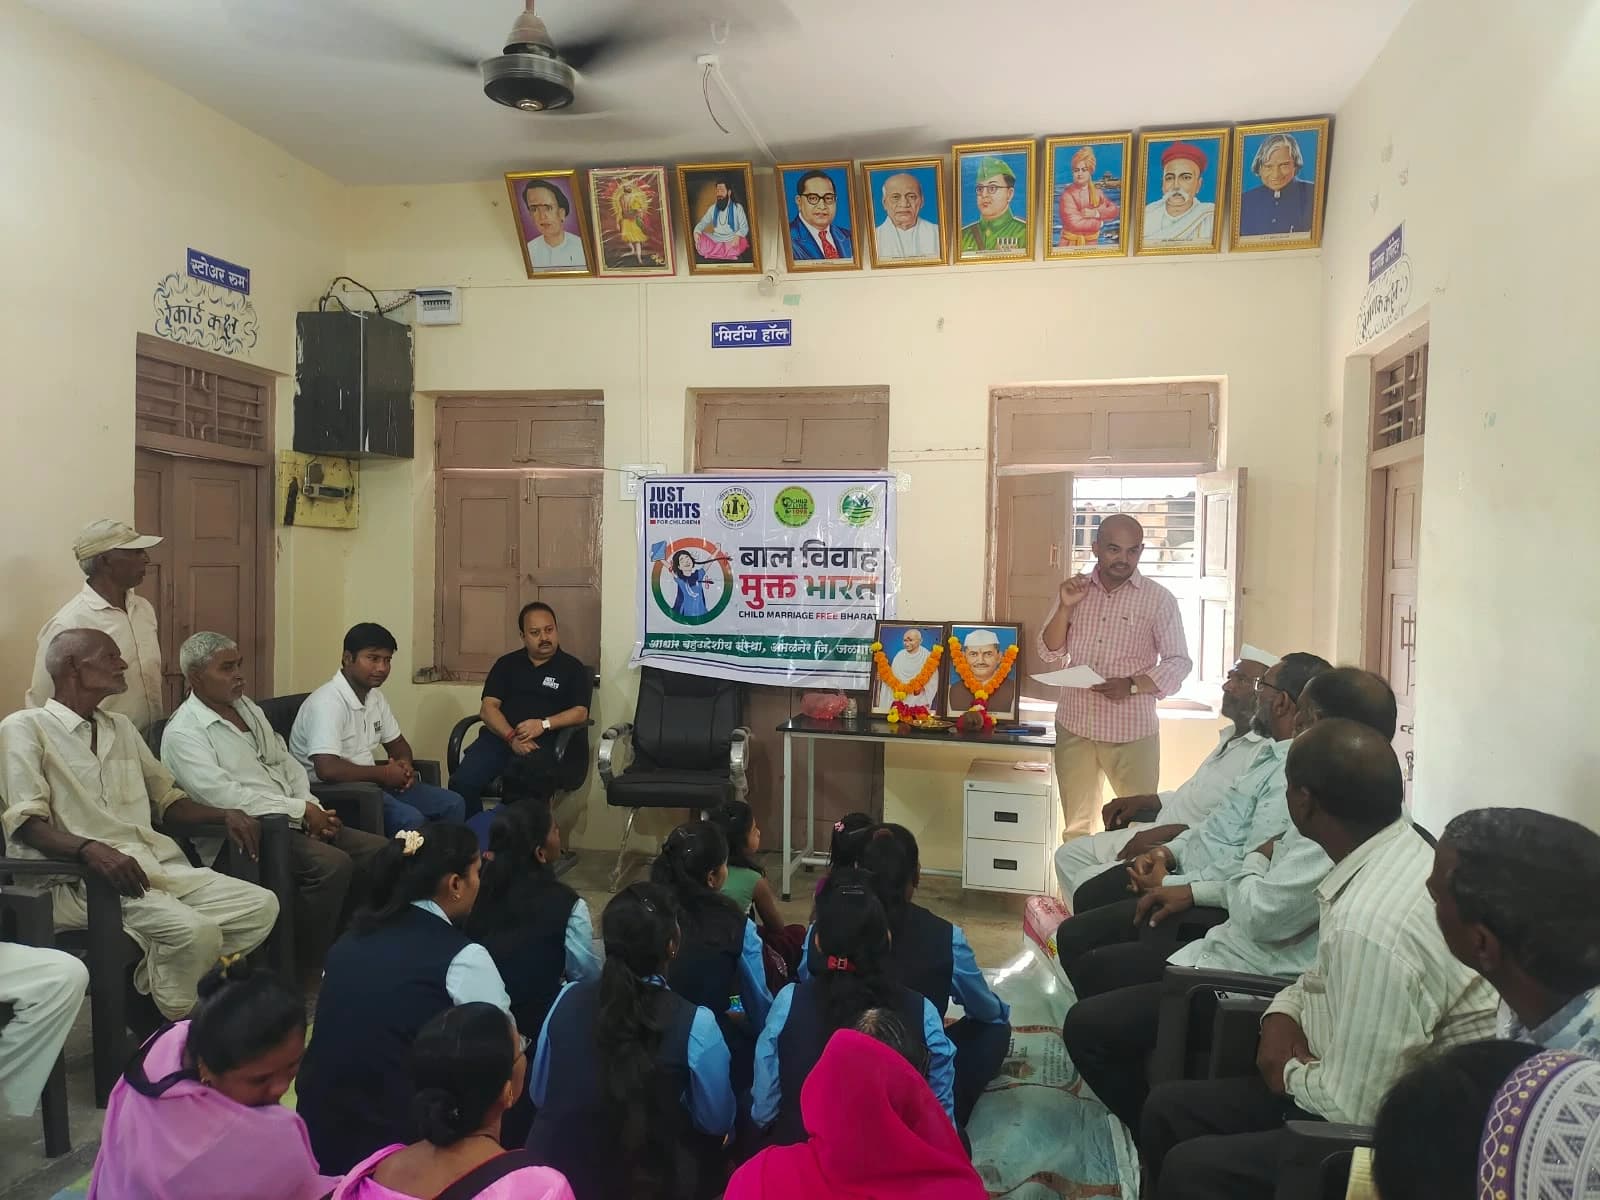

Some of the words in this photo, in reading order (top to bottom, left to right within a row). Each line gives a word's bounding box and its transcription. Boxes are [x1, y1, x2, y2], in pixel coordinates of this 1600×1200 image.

[761, 324, 787, 342] हॉल
[650, 486, 685, 502] JUST
[649, 502, 701, 519] RIGHTS
[738, 546, 795, 568] बाल
[800, 538, 880, 573] विवाह
[738, 574, 799, 610] मुक्त
[803, 574, 880, 600] भारत
[738, 610, 765, 618] CHILD
[766, 611, 814, 620] MARRIAGE
[815, 612, 838, 620] FREE
[840, 613, 878, 621] BHARAT
